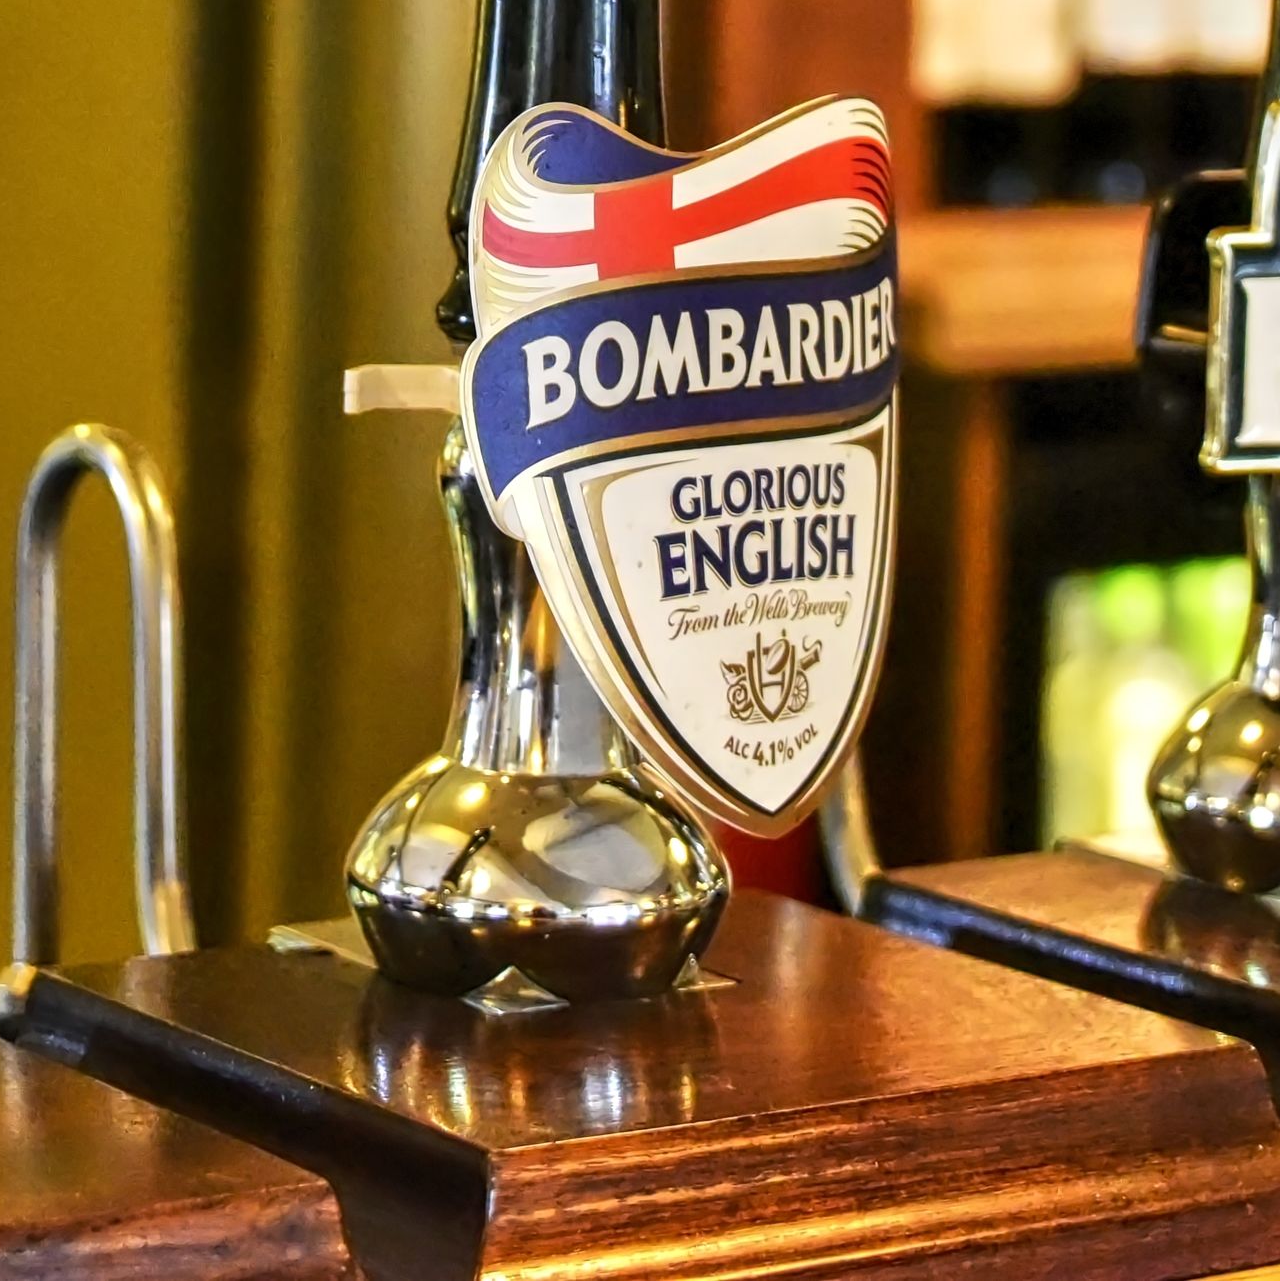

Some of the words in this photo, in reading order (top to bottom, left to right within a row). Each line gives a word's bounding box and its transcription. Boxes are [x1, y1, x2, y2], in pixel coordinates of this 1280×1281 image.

[522, 276, 896, 431] BOMBARDIER
[671, 462, 846, 523] GLORIOUS
[653, 514, 857, 600] ENGLISH
[668, 605, 720, 640] From
[723, 602, 746, 627] the
[746, 589, 789, 626] Wells
[790, 589, 852, 627] Brewery
[724, 735, 750, 759] ALC
[752, 737, 794, 766] 4.1%
[794, 723, 819, 751] VOL
